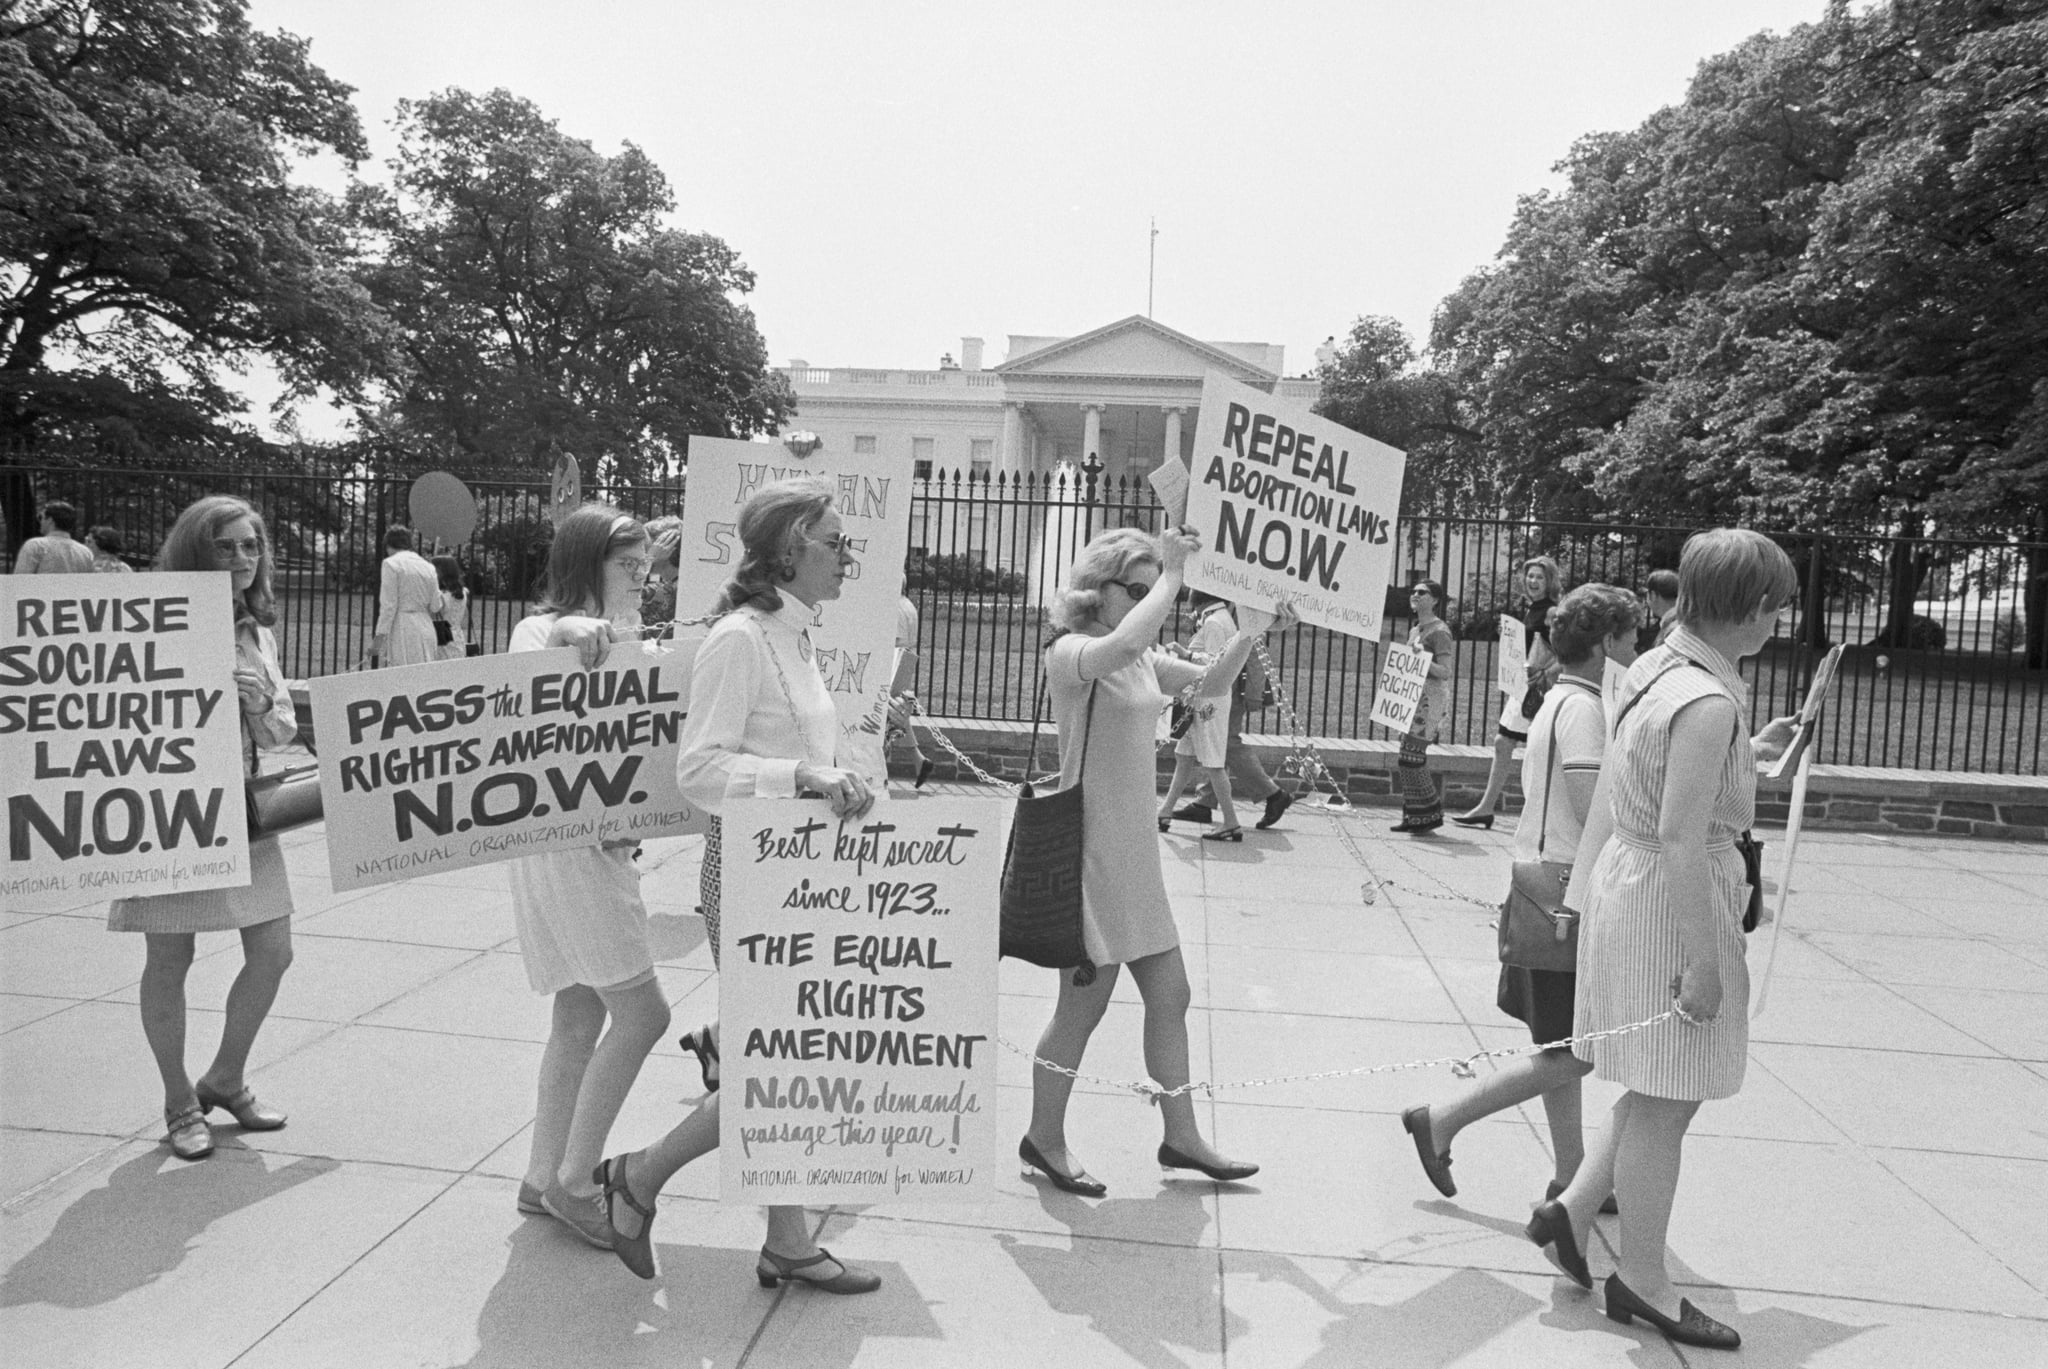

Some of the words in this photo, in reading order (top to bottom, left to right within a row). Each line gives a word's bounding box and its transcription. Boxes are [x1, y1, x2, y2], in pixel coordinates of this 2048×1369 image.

[1222, 401, 1357, 497] REPEAL
[735, 463, 891, 519] HAN
[1203, 455, 1334, 529] ABORTION
[1336, 502, 1390, 545] LAWS
[1215, 500, 1347, 592] N.O.W.
[16, 597, 190, 638] REVISE
[1201, 563, 1252, 590] NATIONAL
[1256, 578, 1324, 612] ORGANIZATION
[1342, 607, 1375, 628] WOMEN
[0, 641, 185, 687] SOCIAL
[1387, 650, 1425, 678] EQUAL
[346, 684, 486, 745] PASS
[487, 683, 525, 718] the
[531, 666, 680, 719] EQUAL
[859, 684, 891, 736] Women
[1379, 673, 1422, 703] RIGHTS
[0, 688, 224, 735] SECURITY
[34, 736, 197, 780] LAWS
[339, 738, 481, 793] RIGHTS
[488, 710, 687, 767] AMENDMEN
[393, 755, 649, 843] N.O.W.
[8, 787, 229, 862] N.O.W.
[752, 818, 828, 864] Best
[833, 819, 896, 876] kept
[884, 823, 979, 868] secret
[355, 847, 456, 878] NATIONAL
[469, 819, 594, 858] ORGANIZATION
[0, 876, 70, 896] NATIONAL
[79, 870, 169, 889] ORGANIZATION
[781, 878, 860, 914] since
[867, 881, 951, 920] 1923...
[737, 932, 815, 968] THE
[833, 934, 952, 976] EQUAL
[797, 978, 926, 1023] RIGHTS
[743, 1027, 987, 1070] AMENDMENT
[744, 1075, 865, 1115] N.O.W.
[873, 1080, 981, 1116] demands
[740, 1125, 837, 1159] passage
[832, 1115, 876, 1147] this
[741, 1168, 802, 1188] NATIONAL
[806, 1167, 888, 1186] ORGANIZATION
[919, 1166, 974, 1185] WOMEN
